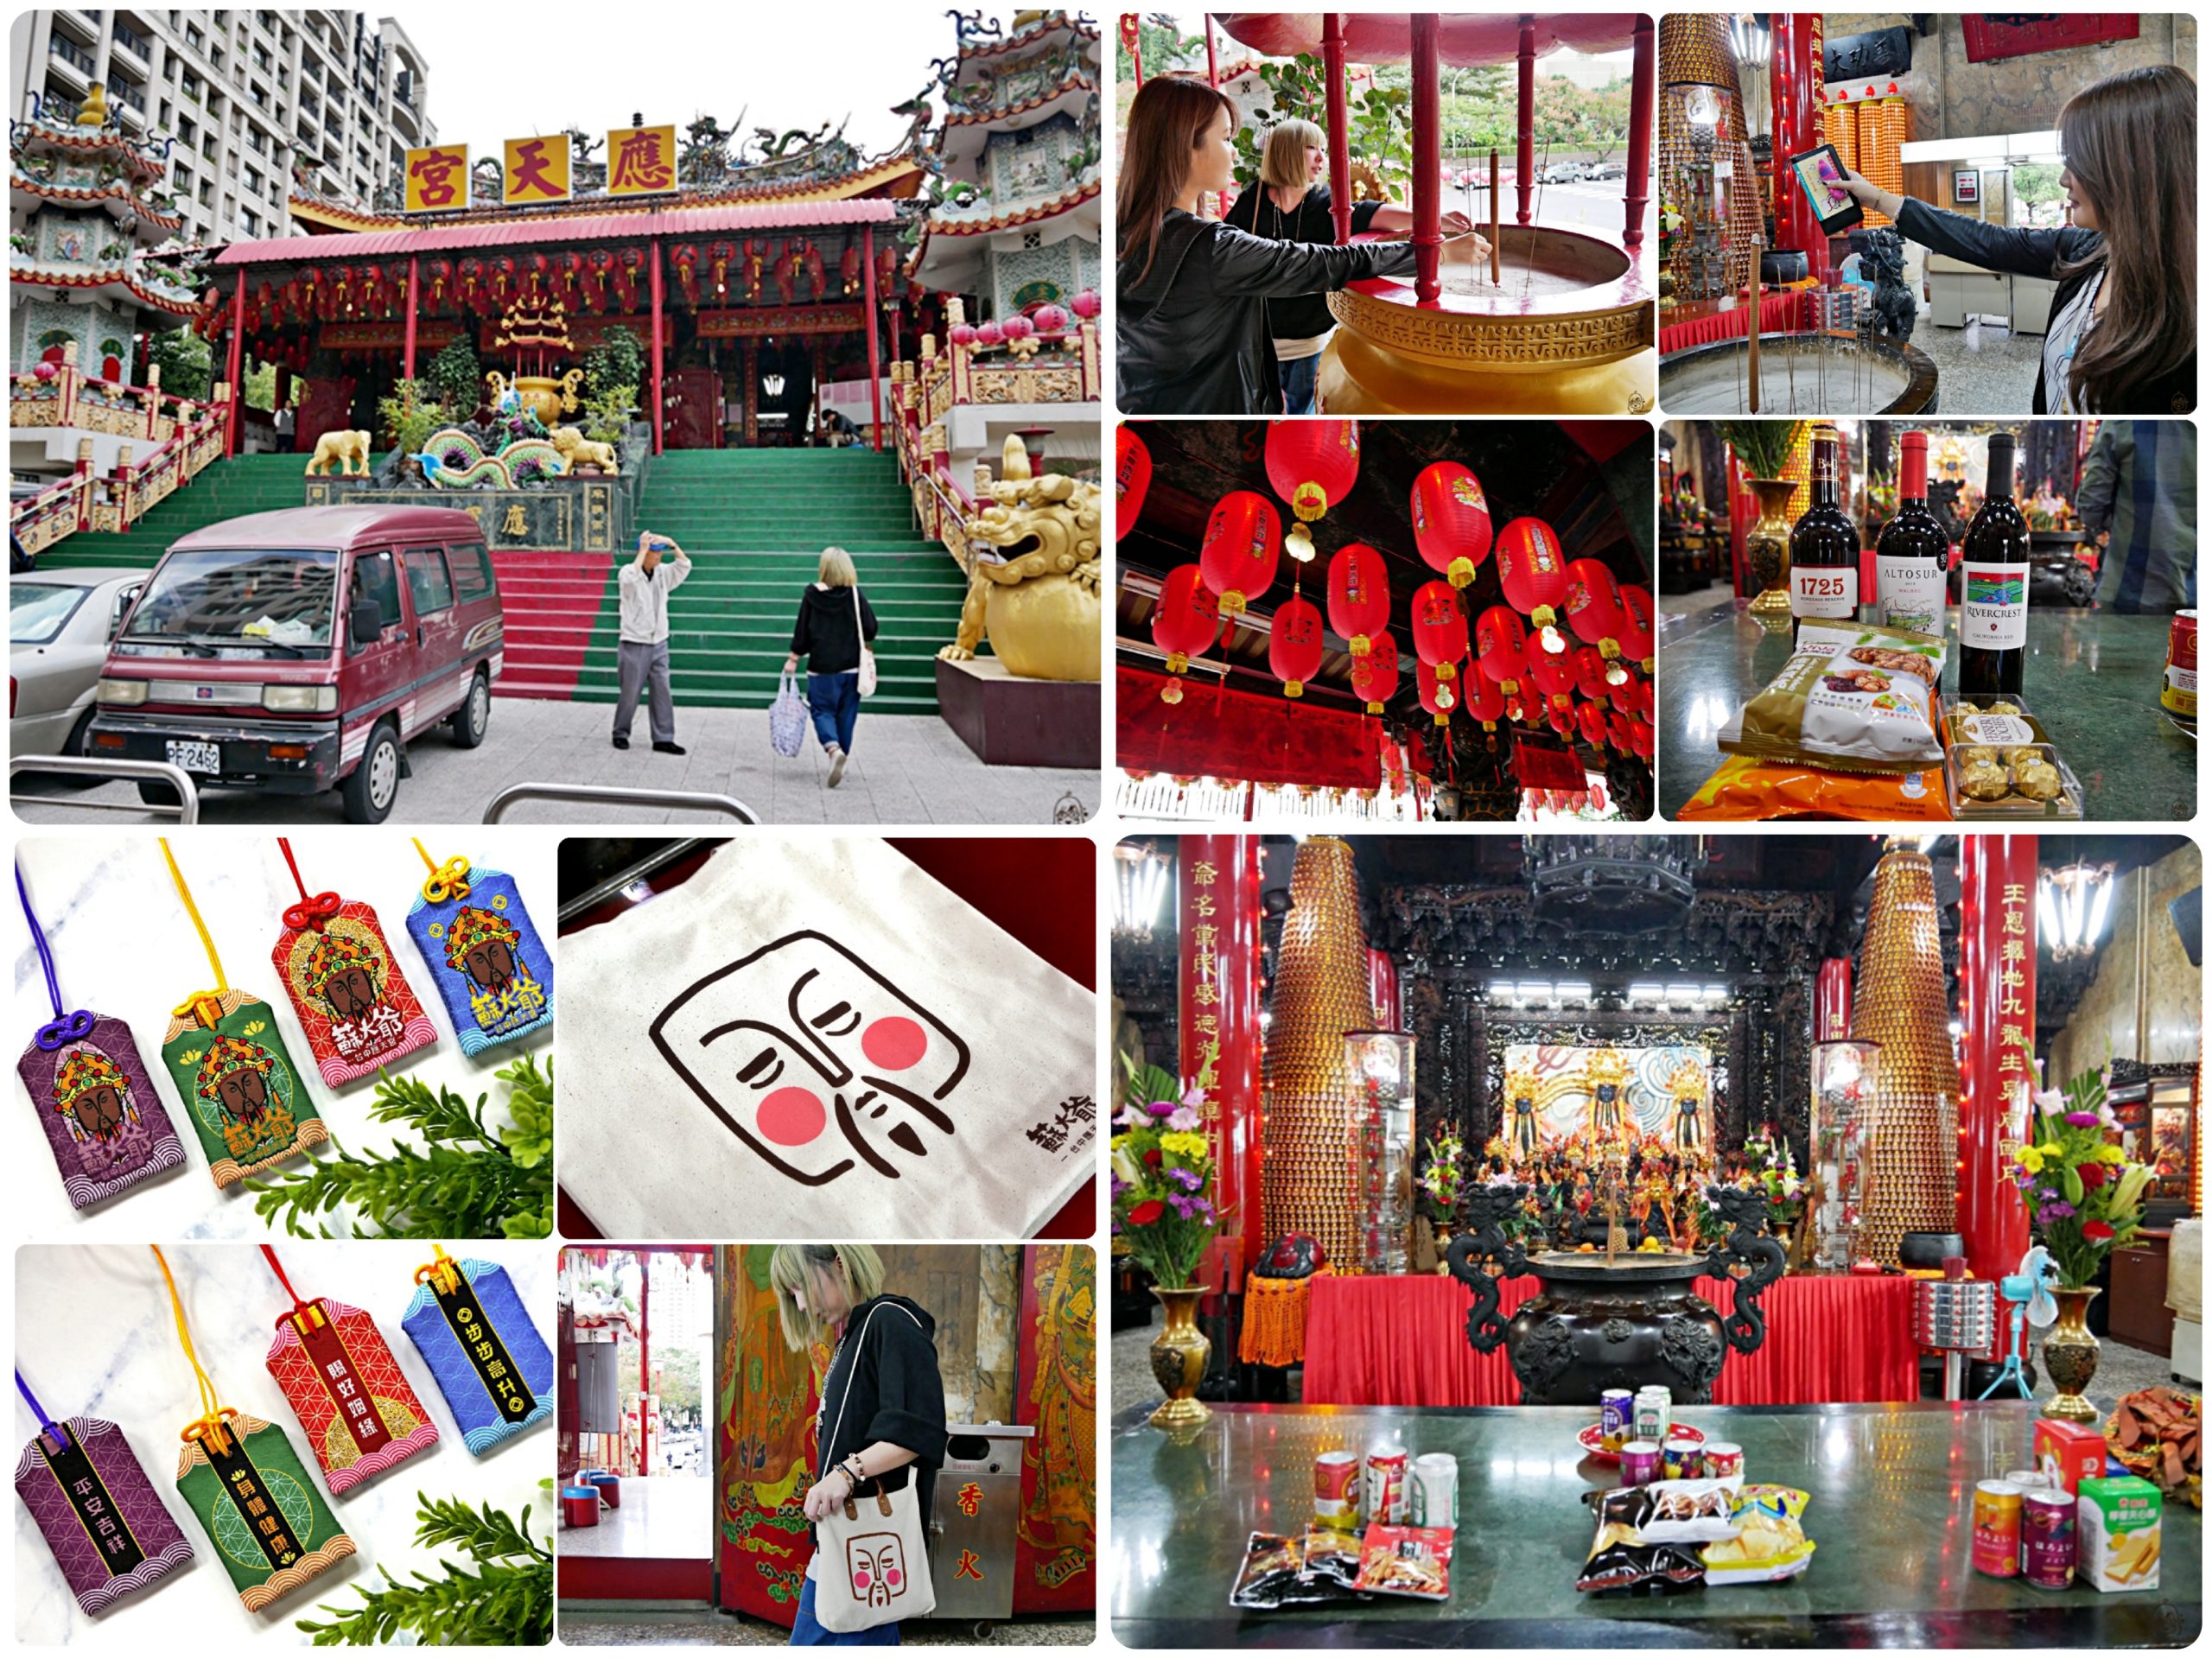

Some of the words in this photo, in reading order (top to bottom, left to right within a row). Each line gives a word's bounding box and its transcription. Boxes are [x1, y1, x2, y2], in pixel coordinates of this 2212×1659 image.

[1800, 577, 1844, 595] 1725
[1885, 569, 1937, 579] ALTOSUR
[1967, 606, 2021, 618] RIVERCREST
[332, 1004, 404, 1056] 蘇大爺
[465, 1322, 516, 1398] 步步高升
[326, 1359, 378, 1438] 賜好姻緣
[73, 1477, 126, 1554] 平安吉祥
[236, 1478, 289, 1555] 身體健康
